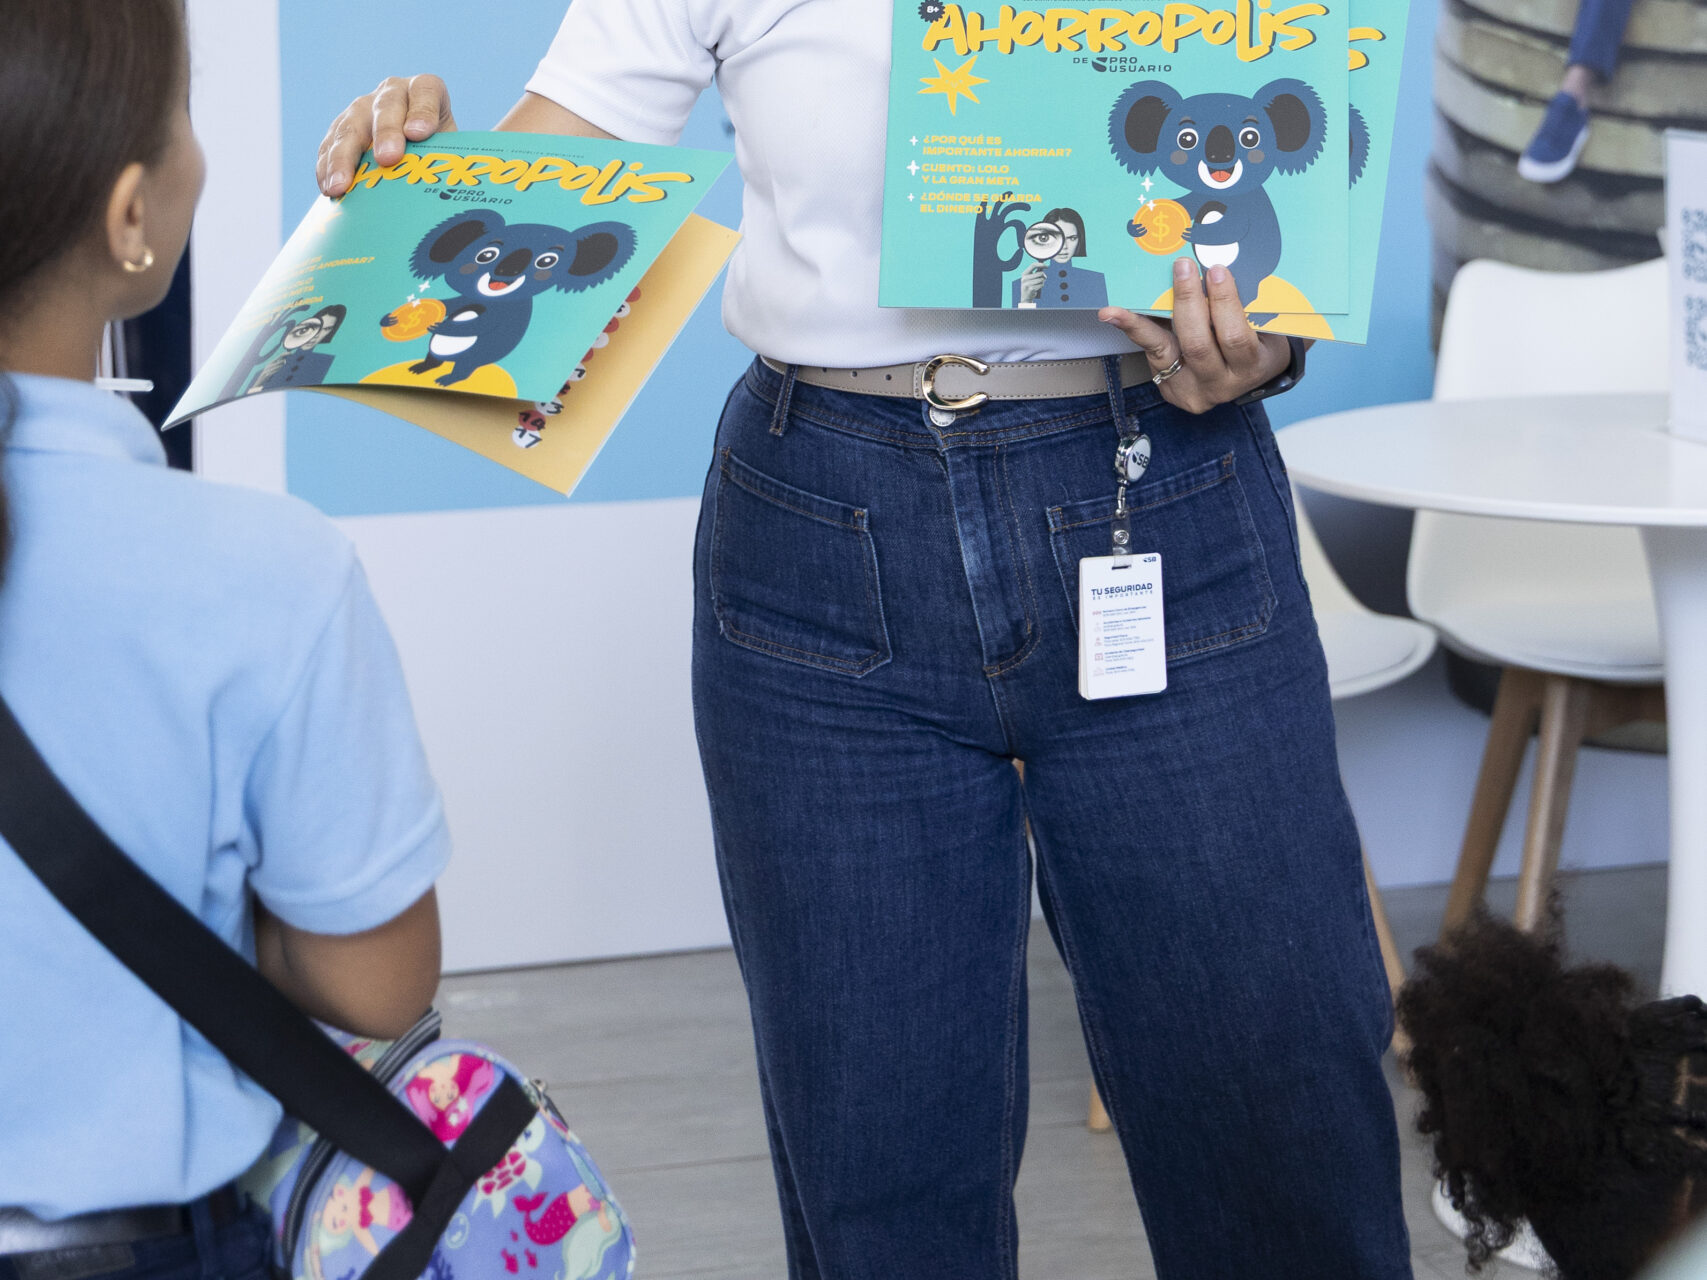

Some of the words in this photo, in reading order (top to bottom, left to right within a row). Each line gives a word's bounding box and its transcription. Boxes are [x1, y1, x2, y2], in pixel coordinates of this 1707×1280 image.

[926, 5, 940, 14] 8+
[1109, 56, 1138, 64] PRO
[1109, 64, 1172, 73] USUARIO
[923, 135, 957, 144] ¿POR
[959, 134, 984, 146] QUÉ
[986, 136, 1002, 145] ES
[922, 146, 1002, 156] IMPORTANTE
[1004, 148, 1072, 157] AHORRAR?
[921, 163, 976, 173] CUENTO:
[977, 164, 1010, 174] LOLO
[921, 175, 930, 184] Y
[932, 175, 947, 184] LA
[949, 176, 984, 185] GRAN
[986, 176, 1020, 186] META
[457, 189, 485, 197] PRO
[920, 190, 971, 202] ¿DÓNDE
[973, 193, 988, 202] SE
[990, 193, 1042, 203] GUARDA
[453, 195, 513, 205] USUARIO
[919, 203, 935, 213] EL
[936, 204, 983, 214] DINERO
[1136, 453, 1150, 469] SB
[1091, 588, 1103, 596] TU
[1104, 582, 1153, 595] SEGURIDAD
